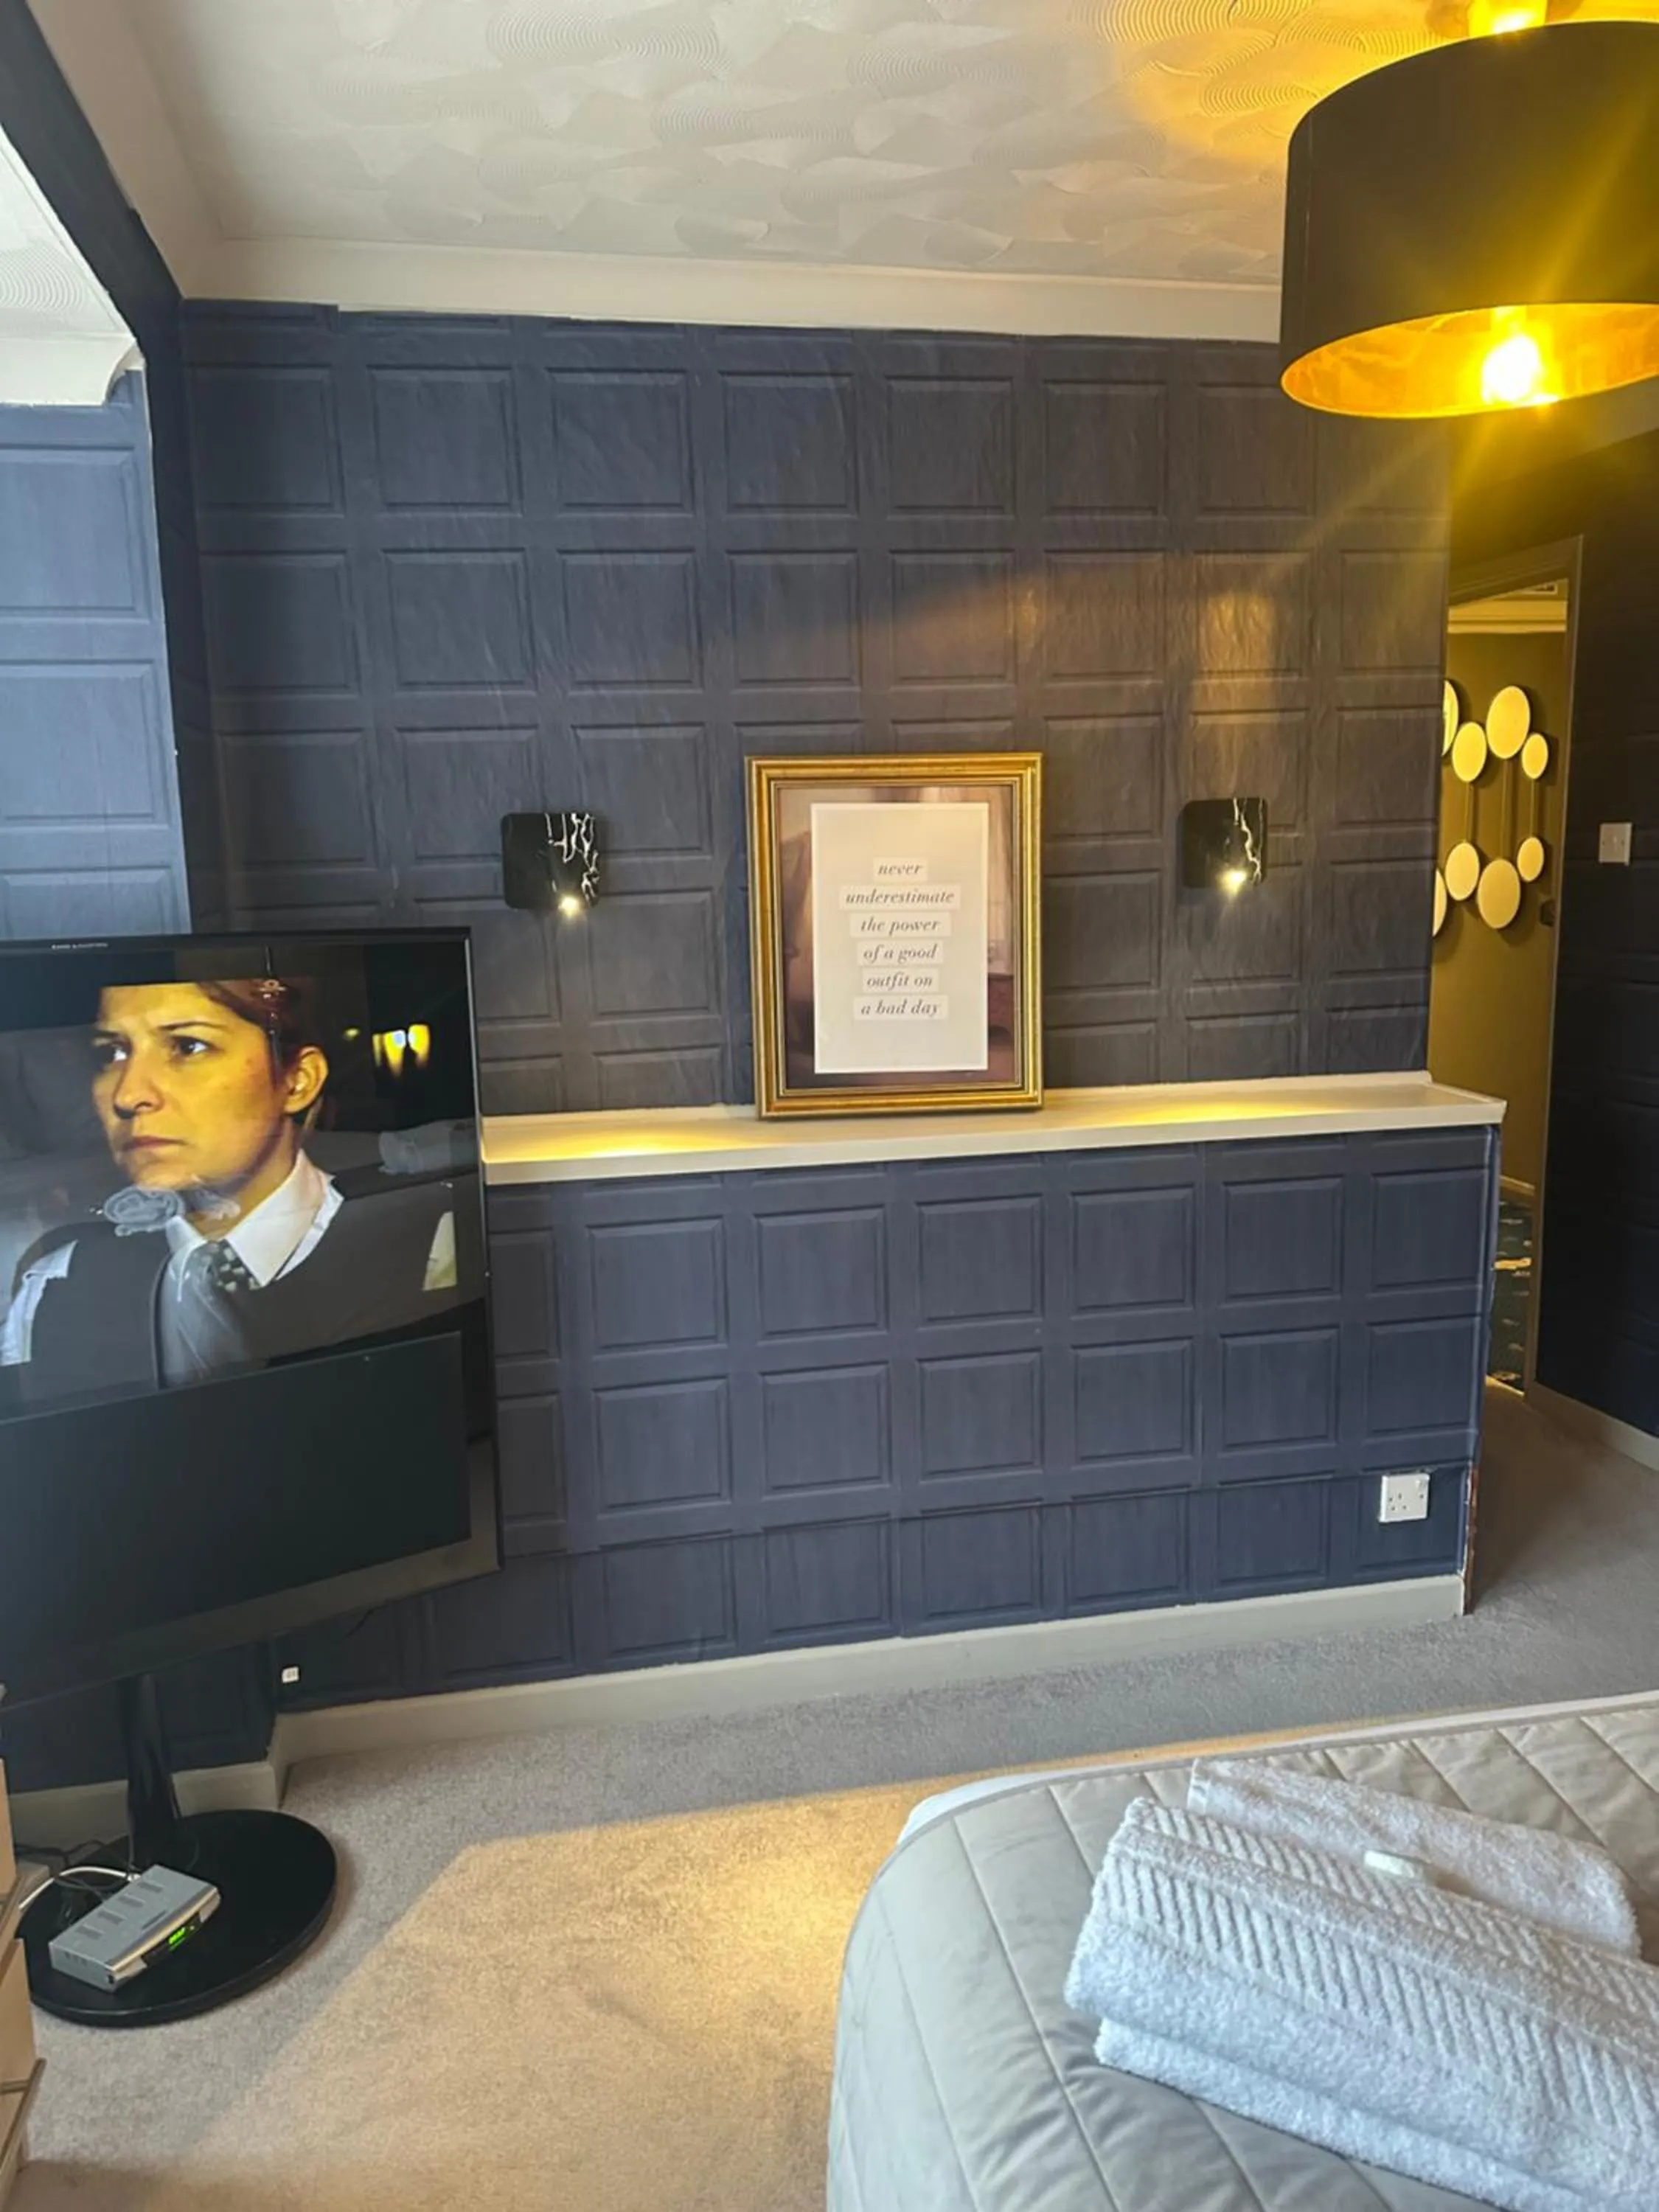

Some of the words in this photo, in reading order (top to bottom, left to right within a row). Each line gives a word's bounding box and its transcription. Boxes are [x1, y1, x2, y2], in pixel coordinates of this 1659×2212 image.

[877, 864, 923, 875] never
[846, 888, 955, 903] underestimate
[860, 916, 885, 931] the
[888, 920, 939, 936] power
[863, 944, 885, 964] of
[883, 949, 894, 959] a
[897, 943, 938, 964] good
[866, 971, 909, 991] outfit
[914, 975, 933, 987] on
[860, 1004, 871, 1015] a
[875, 998, 908, 1015] bad
[911, 998, 940, 1018] day
